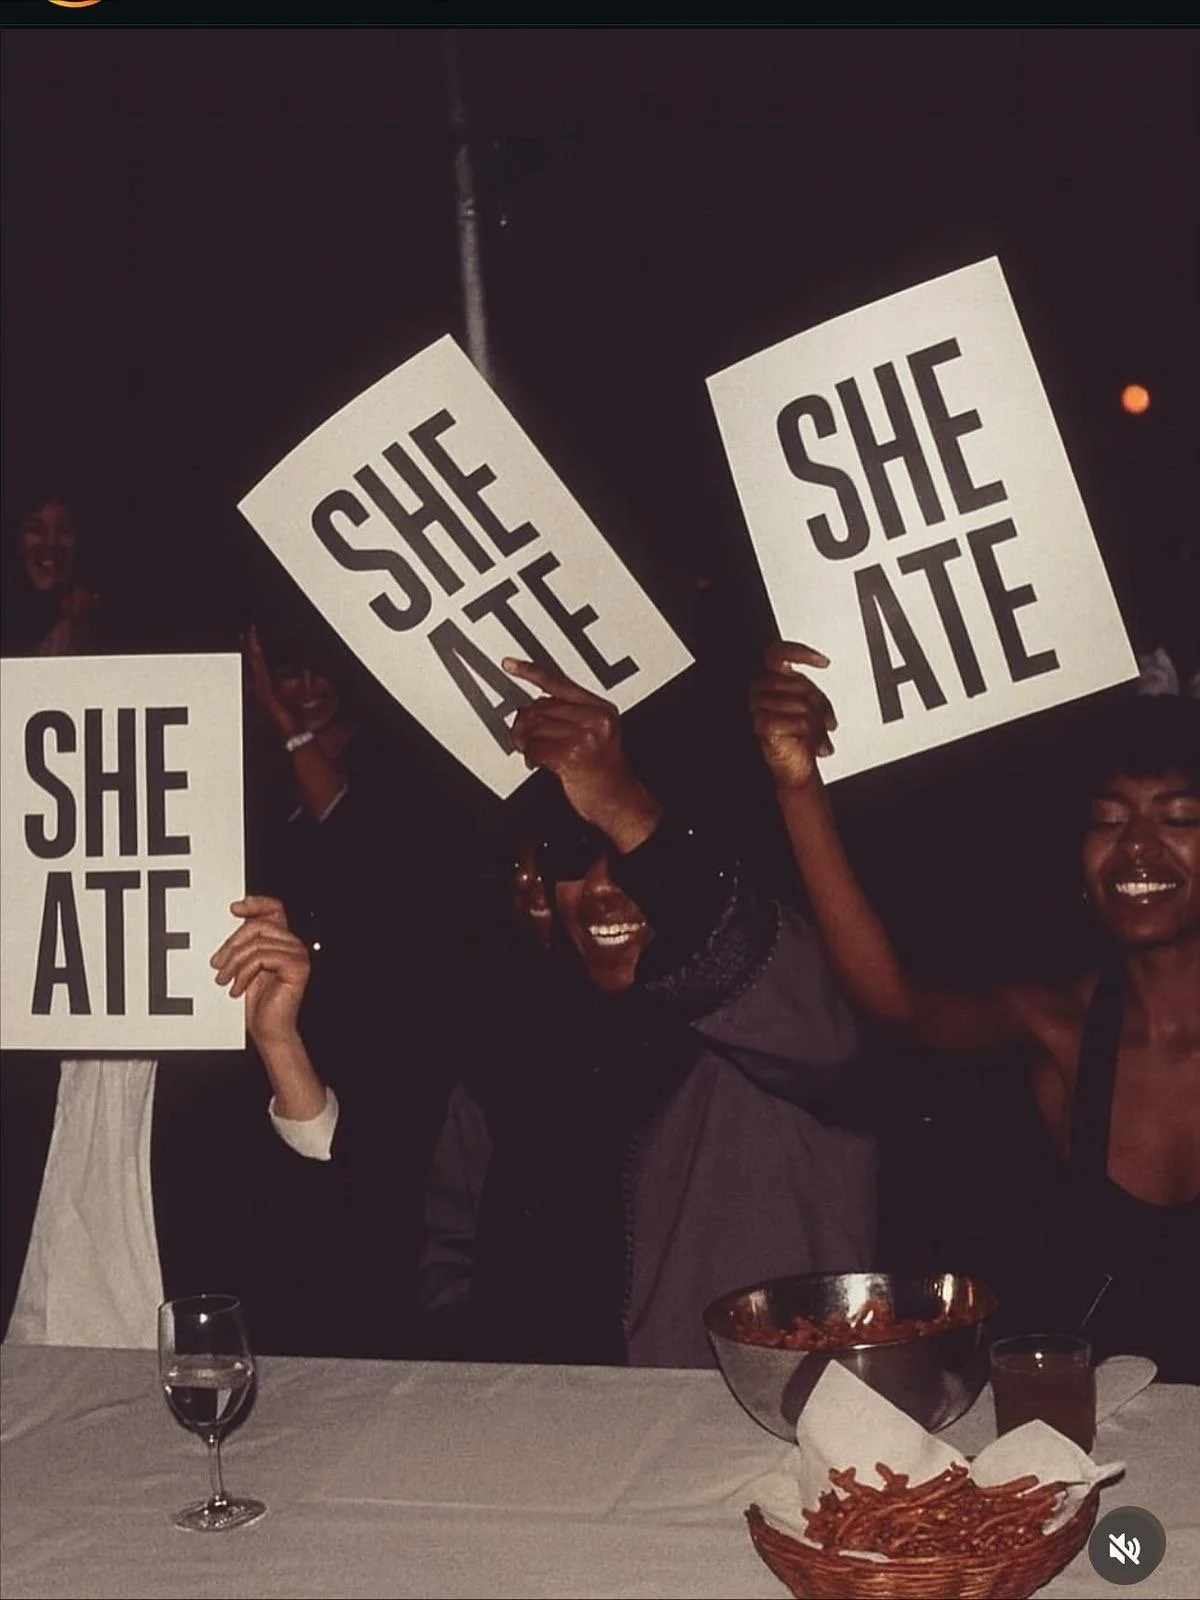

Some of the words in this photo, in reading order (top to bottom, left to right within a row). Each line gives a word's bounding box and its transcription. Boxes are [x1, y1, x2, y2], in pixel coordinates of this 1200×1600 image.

[312, 409, 540, 631] SHE
[777, 338, 1007, 560] SHE
[427, 551, 641, 756] ATE
[854, 518, 1060, 724] ATE
[25, 707, 190, 859] SHE
[32, 870, 194, 1016] ATE
